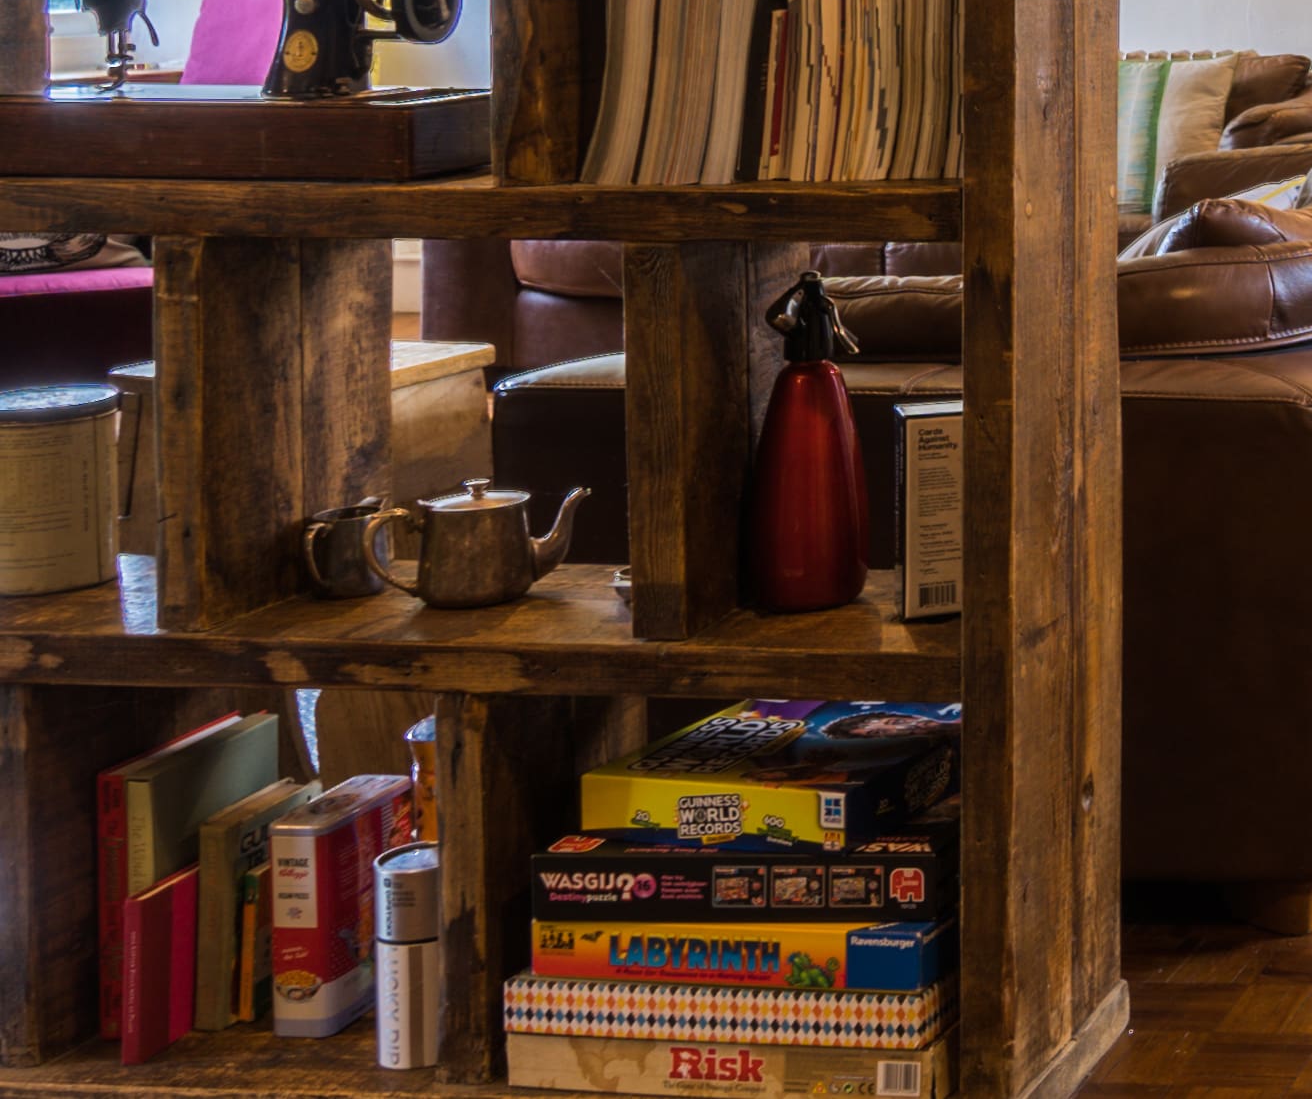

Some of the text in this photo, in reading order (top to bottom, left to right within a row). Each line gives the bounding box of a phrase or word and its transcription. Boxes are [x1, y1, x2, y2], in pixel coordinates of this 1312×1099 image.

[918, 435, 950, 443] Against
[678, 794, 740, 808] GUINNESS
[680, 806, 741, 823] WORLD
[680, 821, 742, 836] RECORDS
[277, 857, 309, 868] VINTAGE
[850, 936, 916, 949] Ravensburger
[608, 932, 781, 973] LABYRINTH
[669, 1046, 764, 1083] Risk
